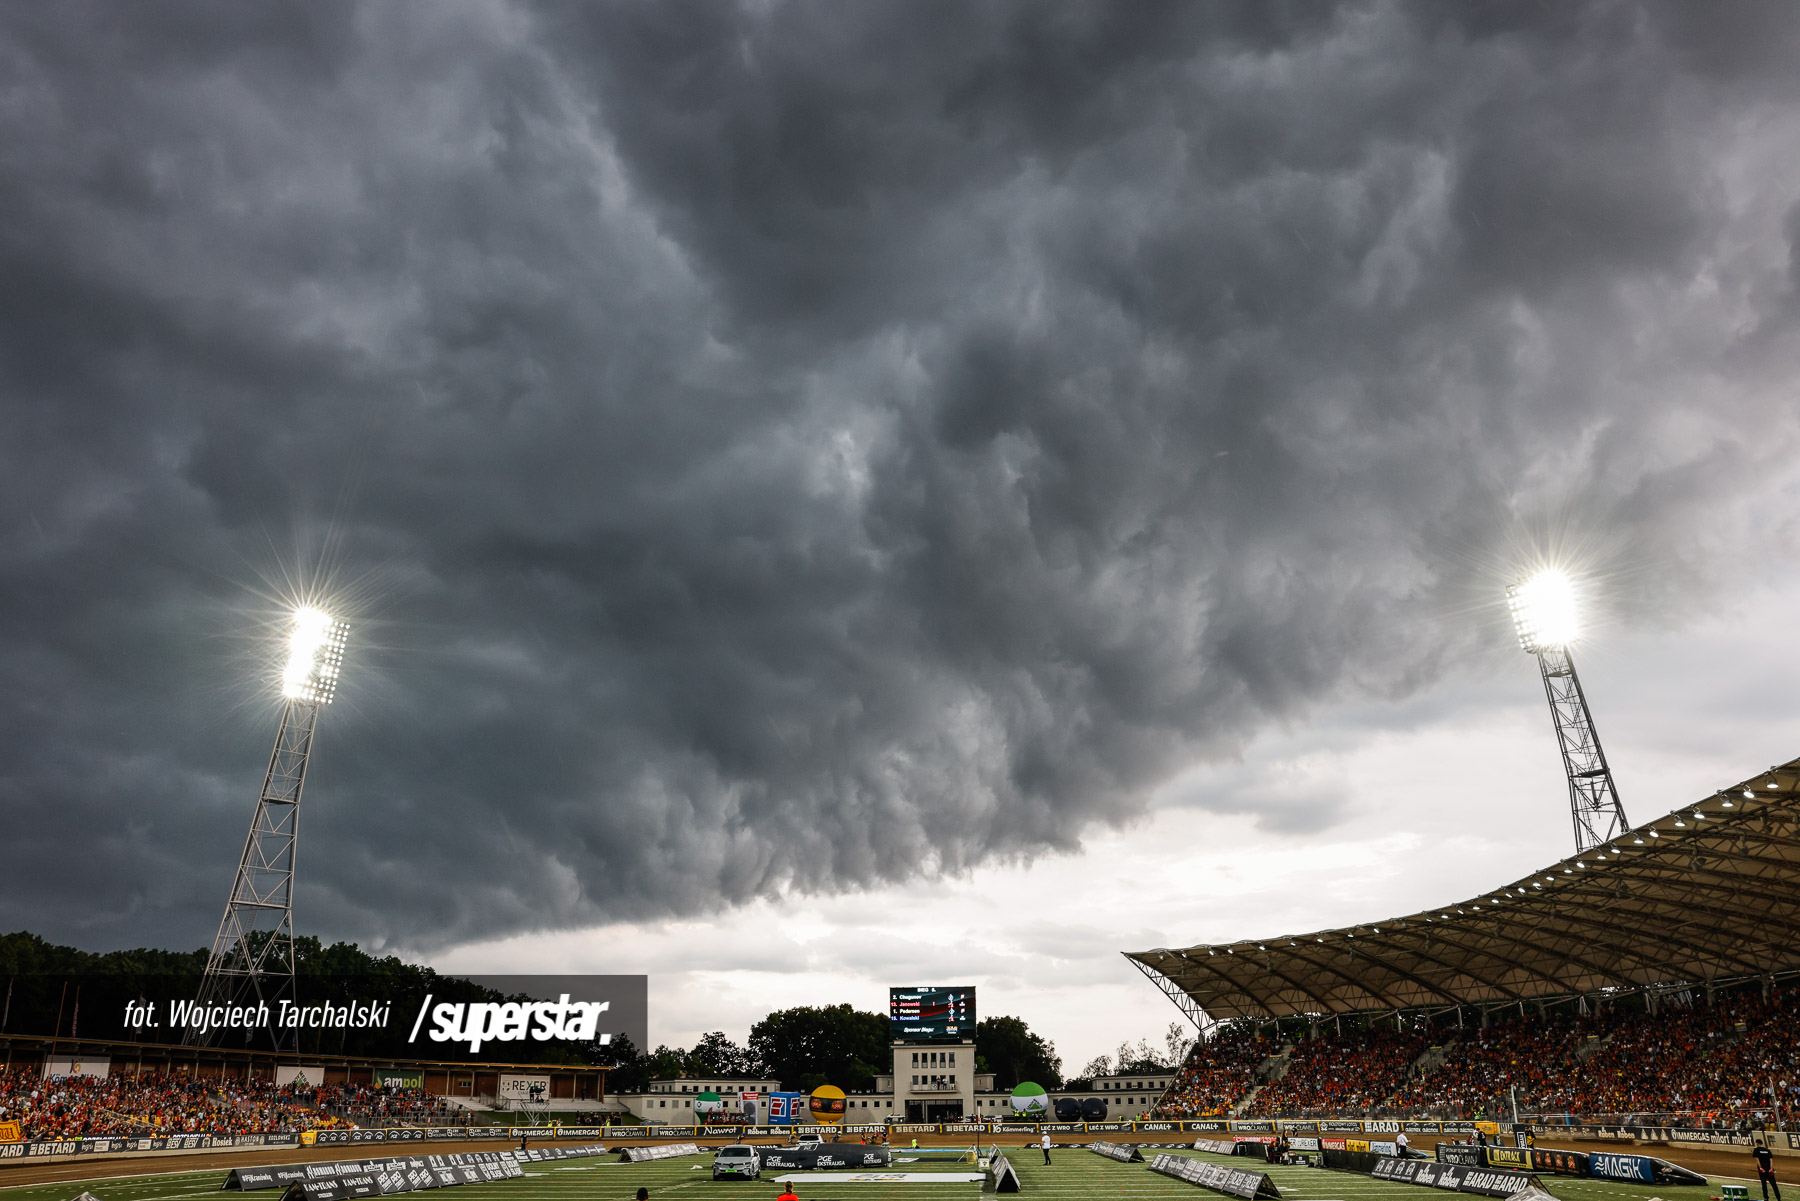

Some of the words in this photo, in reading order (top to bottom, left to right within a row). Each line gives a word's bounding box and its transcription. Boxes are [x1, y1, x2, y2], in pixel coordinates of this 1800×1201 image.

[384, 1076, 422, 1089] ampol
[704, 1126, 736, 1135] Nawrot
[903, 1125, 935, 1133] BETARD
[1675, 1131, 1710, 1142] IMMERGAS
[212, 1138, 232, 1147] Rosiek
[38, 1142, 76, 1155] BETARD
